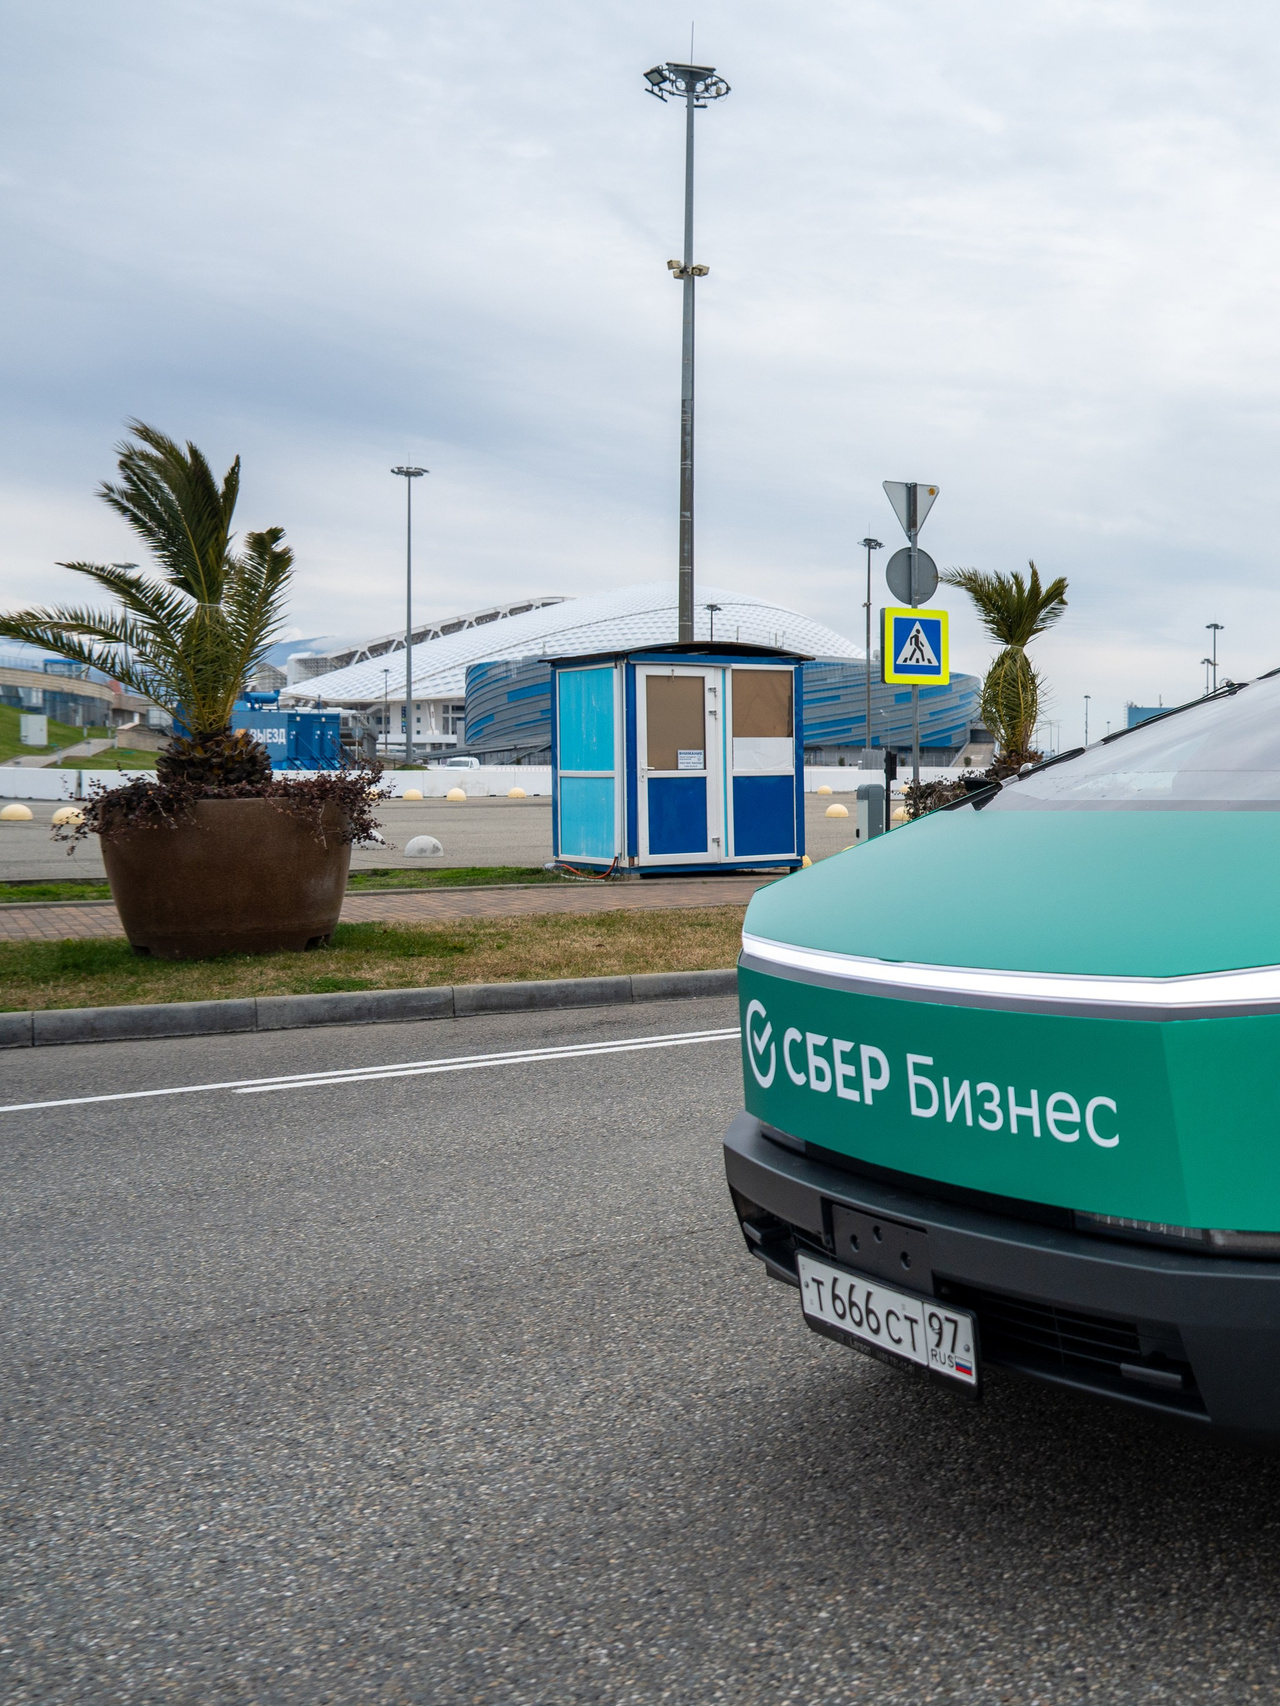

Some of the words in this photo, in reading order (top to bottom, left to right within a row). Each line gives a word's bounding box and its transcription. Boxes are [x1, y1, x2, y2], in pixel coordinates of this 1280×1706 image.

[783, 1027, 890, 1105] СБЕР
[906, 1053, 1120, 1148] Бизнес
[931, 1349, 954, 1368] RUS
